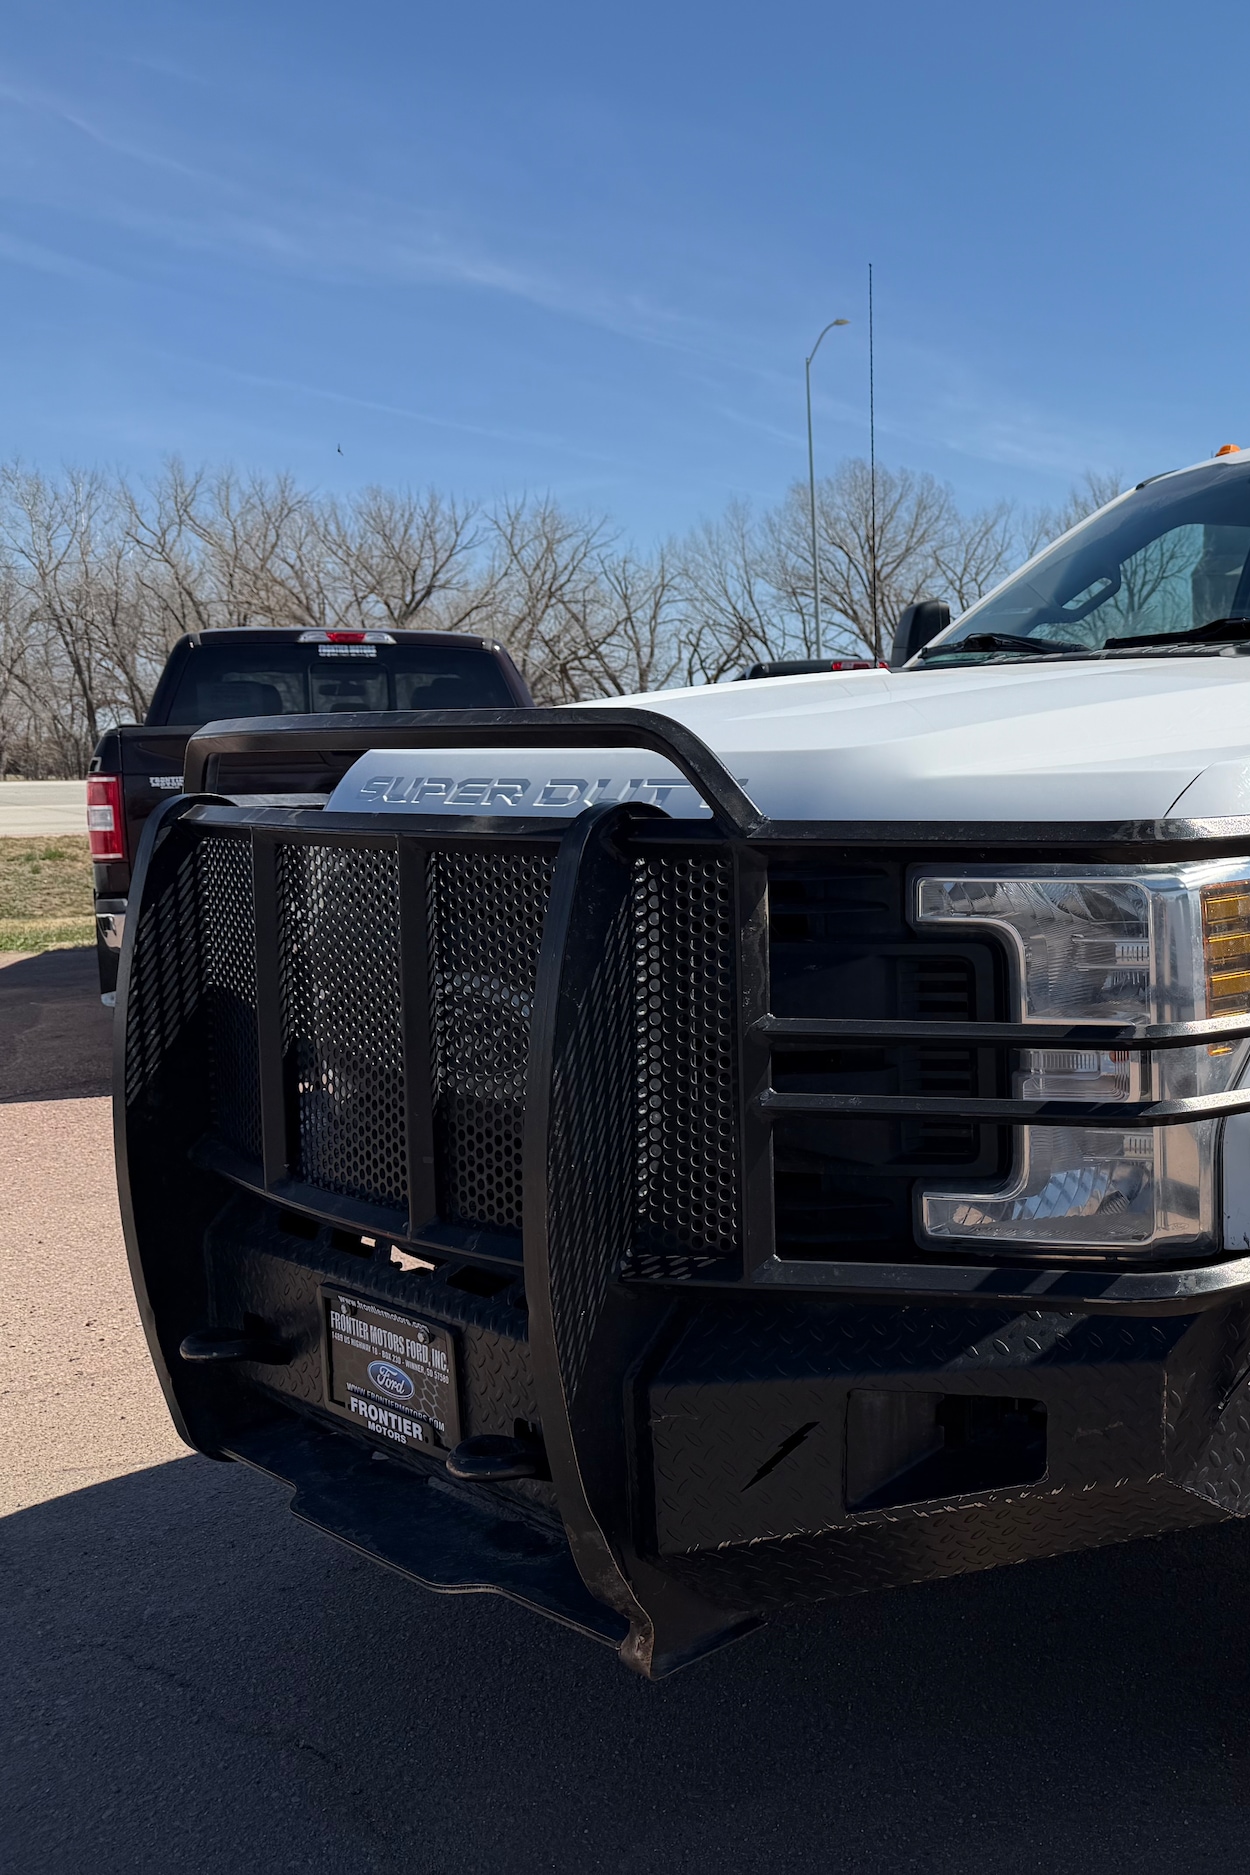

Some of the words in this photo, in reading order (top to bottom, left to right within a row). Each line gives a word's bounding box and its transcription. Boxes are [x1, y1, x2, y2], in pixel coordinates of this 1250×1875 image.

[358, 776, 532, 807] SUPER
[533, 777, 749, 809] DUT
[330, 1310, 369, 1341] FRONTIER
[369, 1324, 405, 1355] MOTORS
[405, 1338, 431, 1367] FORD,
[431, 1348, 450, 1373] INC.
[381, 1350, 391, 1361] BOX
[376, 1365, 405, 1394] Ford
[350, 1396, 423, 1442] FRONTIER
[367, 1420, 407, 1445] MOTORS
